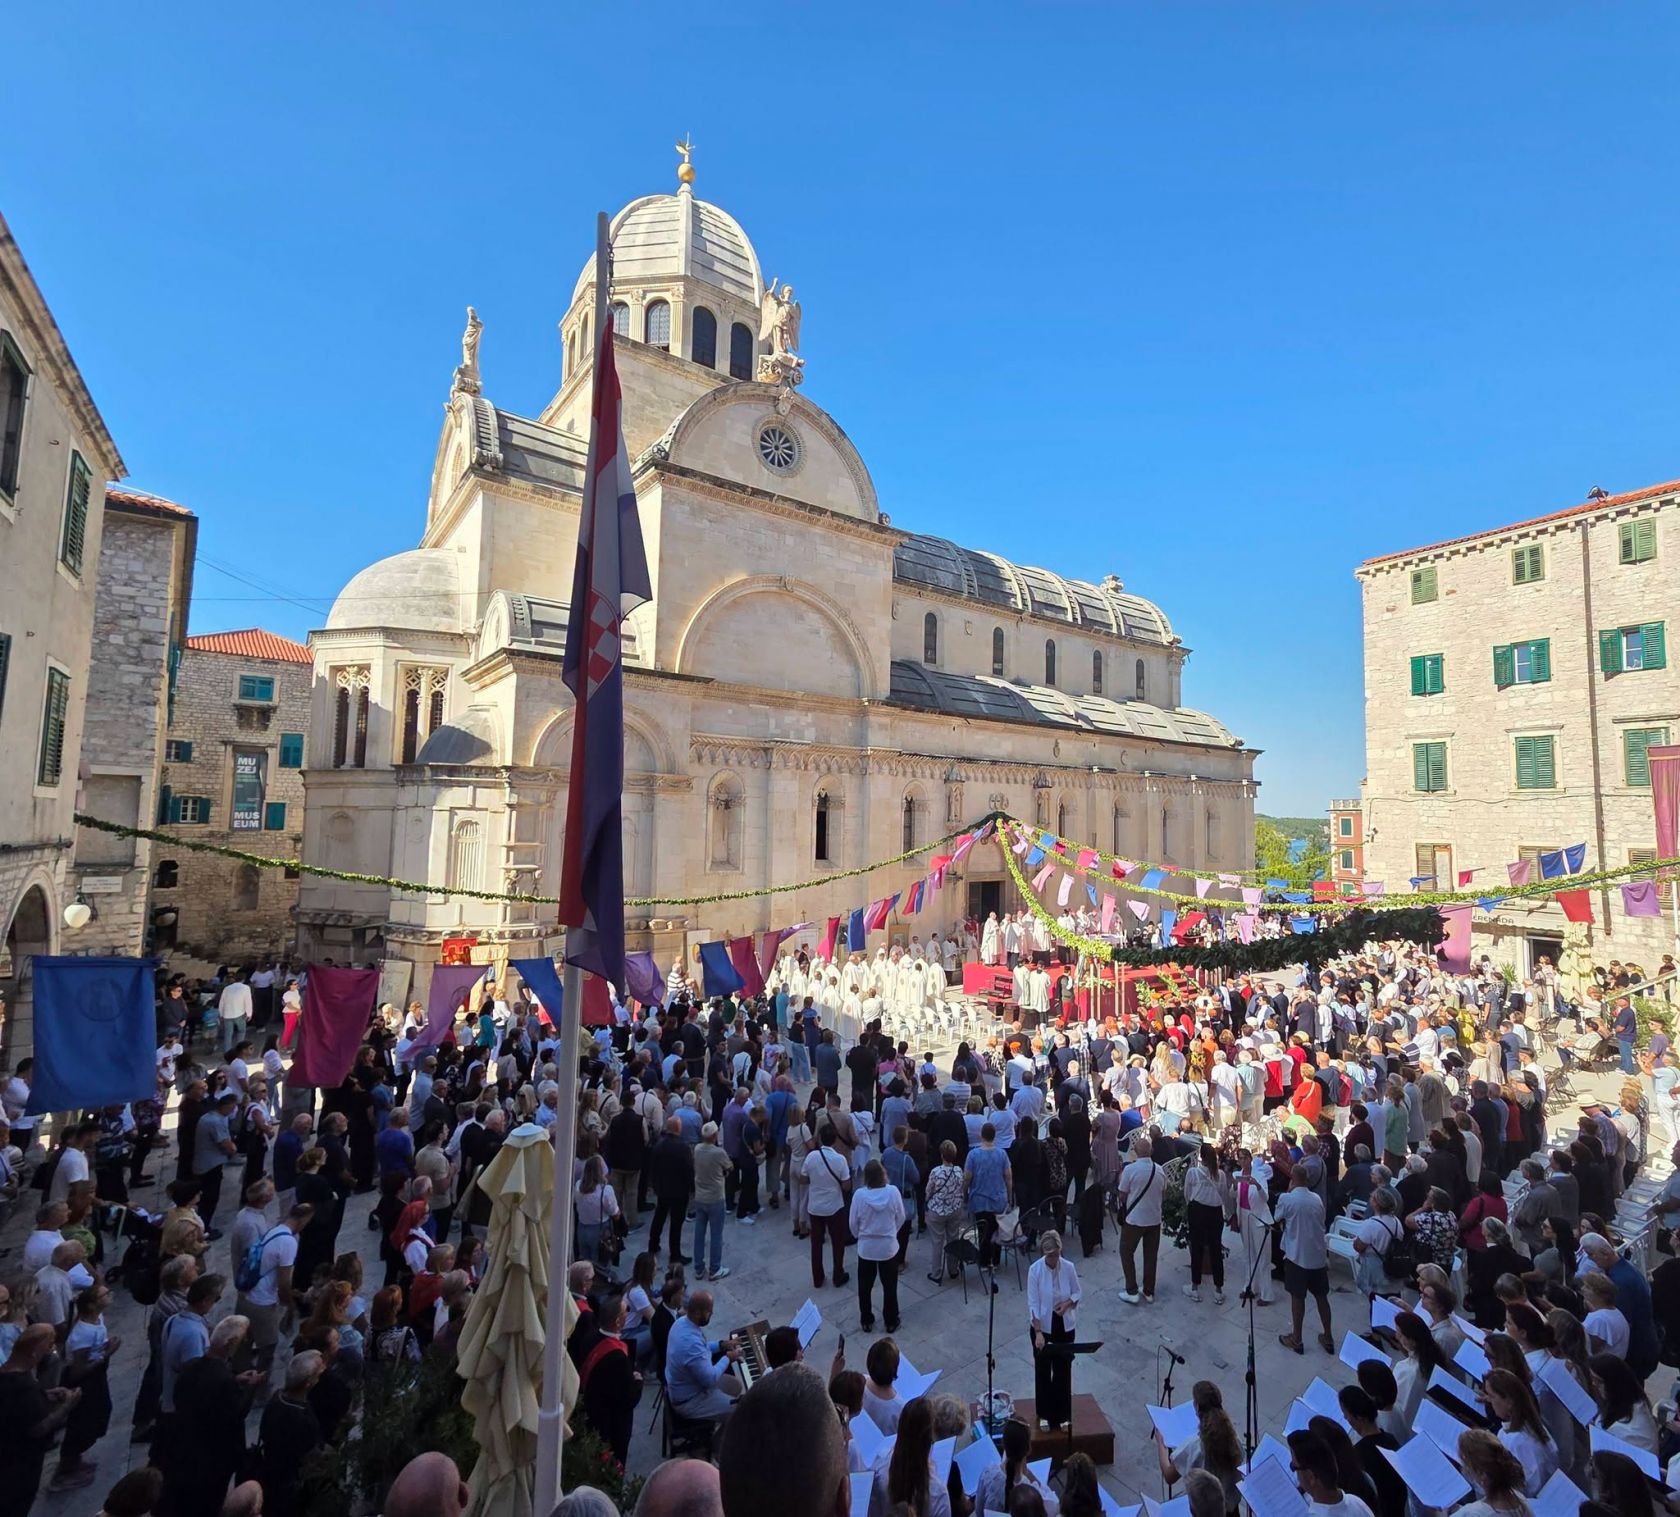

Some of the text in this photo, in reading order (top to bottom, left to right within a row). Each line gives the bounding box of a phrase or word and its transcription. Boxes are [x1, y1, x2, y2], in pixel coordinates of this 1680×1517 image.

[237, 757, 257, 766] MU
[236, 766, 257, 774] ZEJ
[234, 811, 260, 820] MUS
[233, 820, 260, 828] EUM
[1473, 915, 1514, 924] ERENADA
